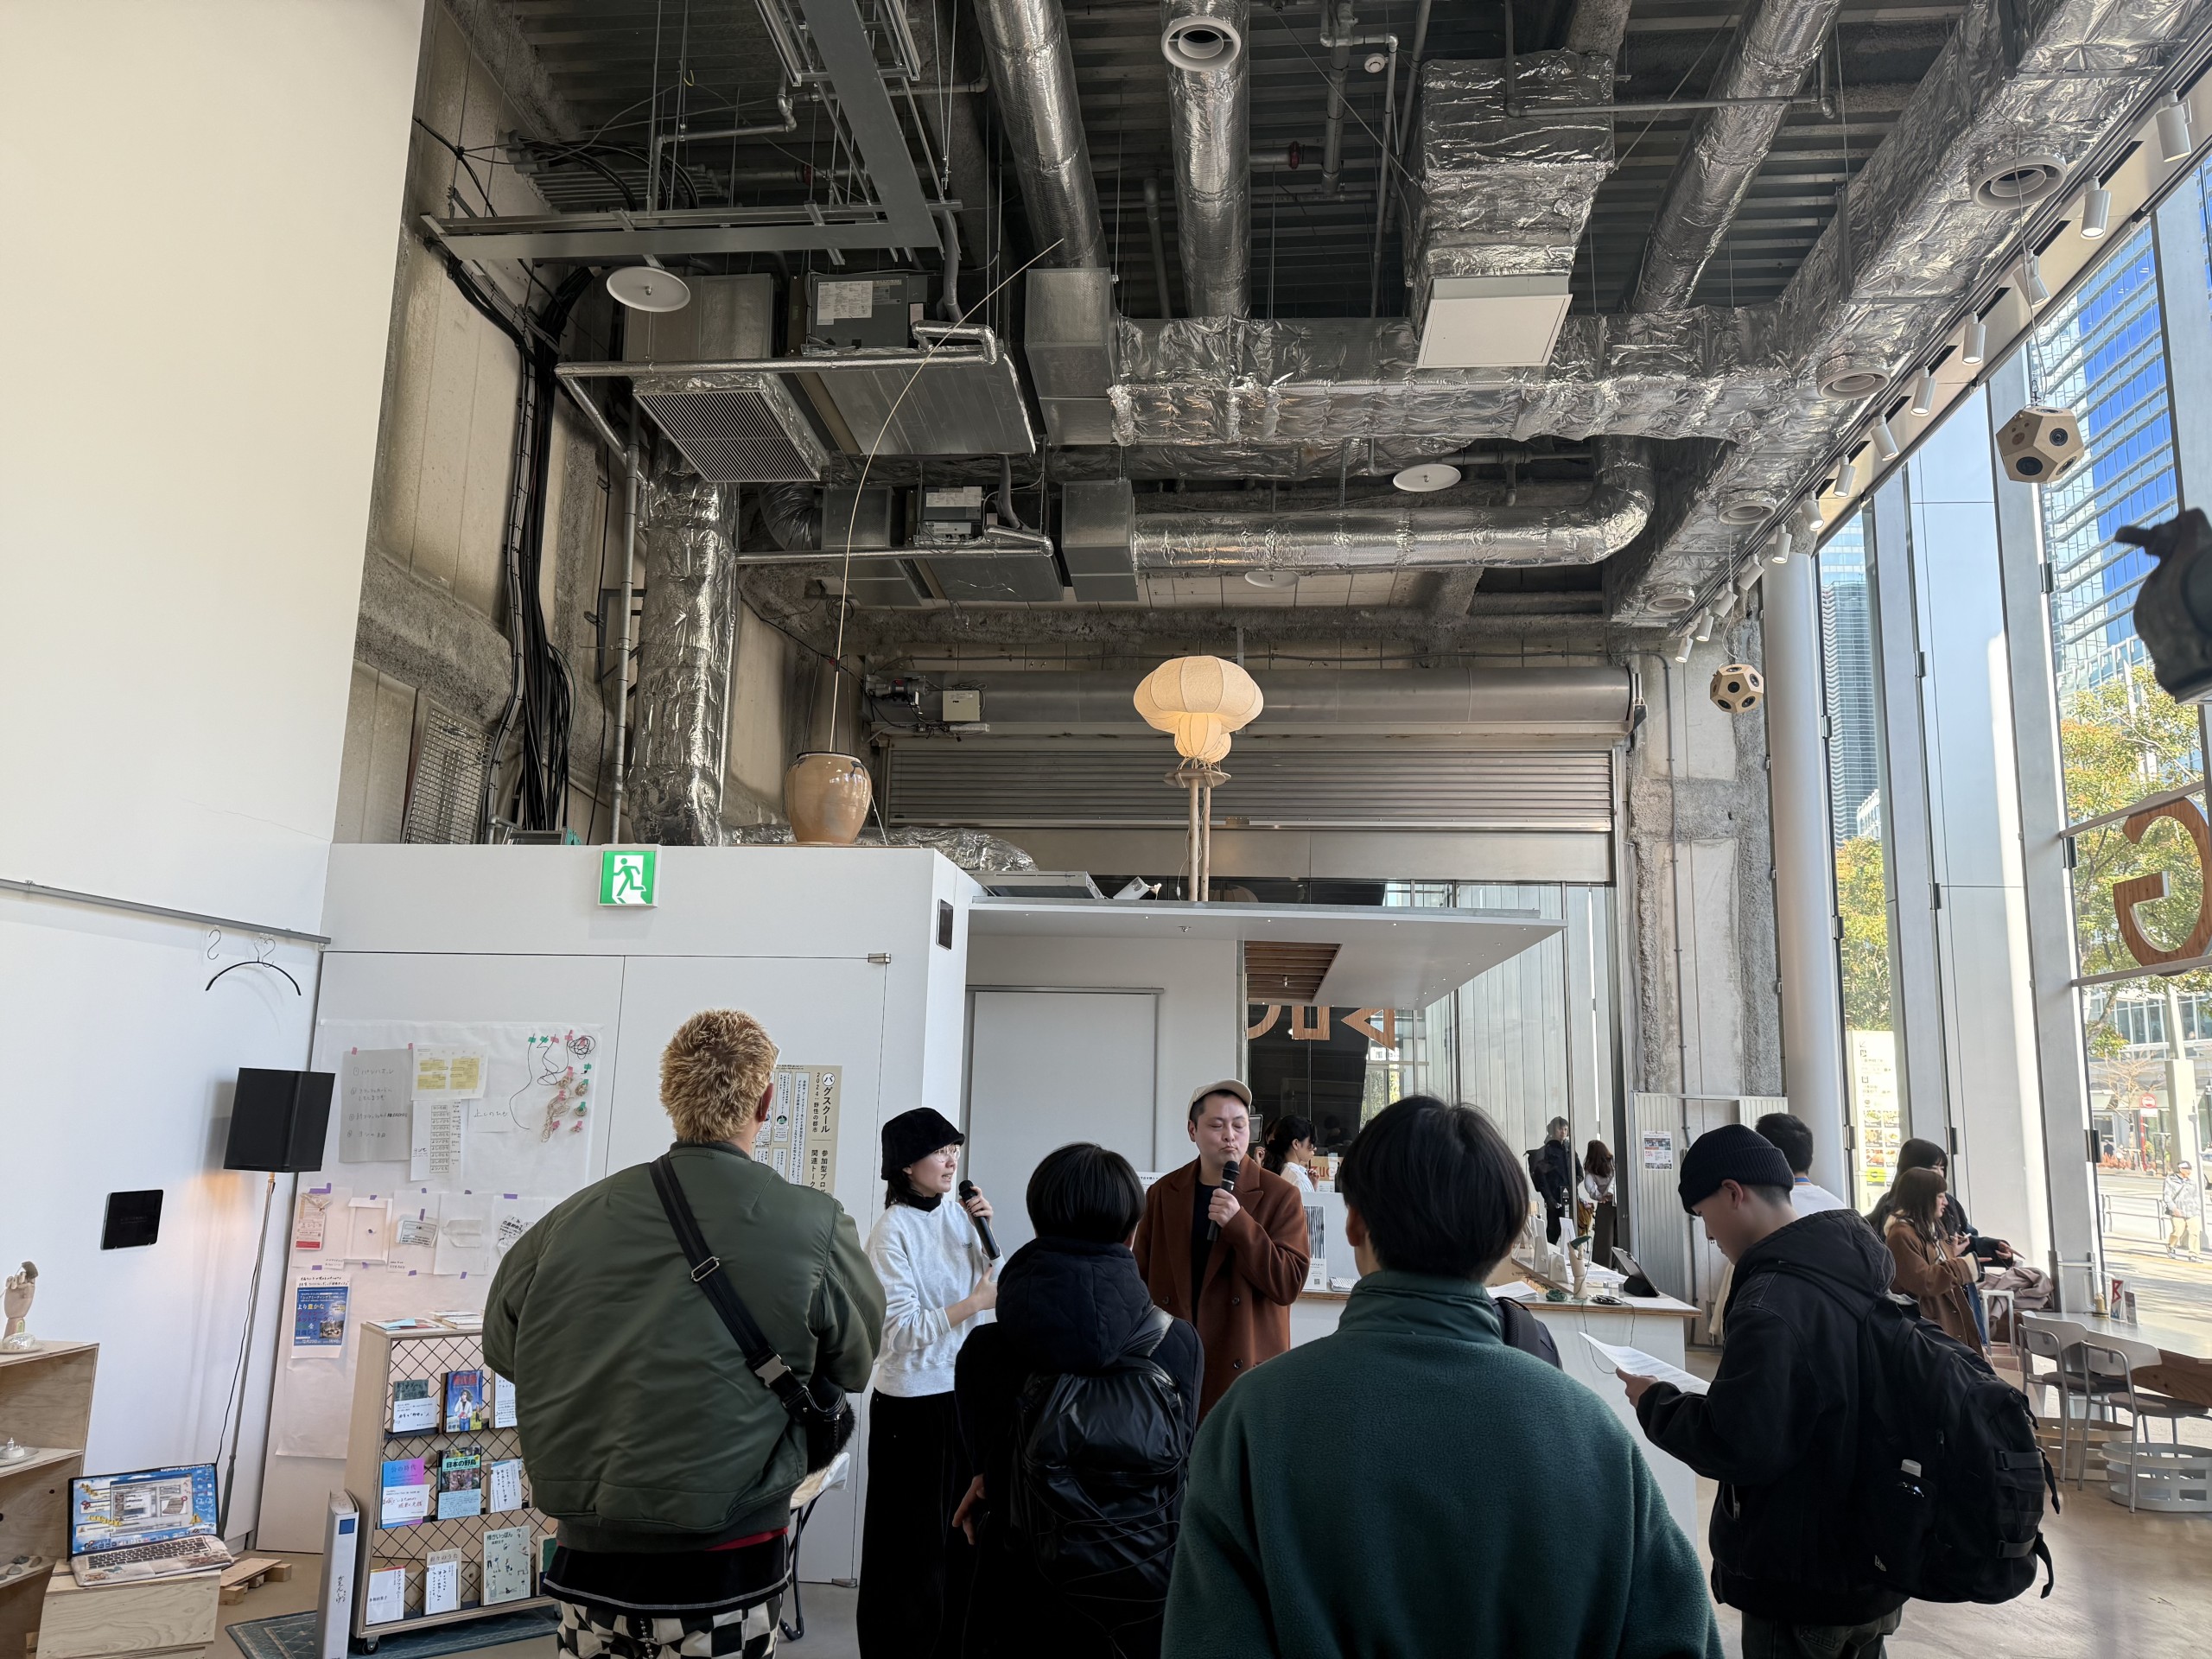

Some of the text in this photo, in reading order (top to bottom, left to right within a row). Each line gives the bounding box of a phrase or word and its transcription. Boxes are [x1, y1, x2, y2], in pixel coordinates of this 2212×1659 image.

[821, 1074, 834, 1134] バグスクール
[446, 1459, 477, 1469] 日本の野鳥
